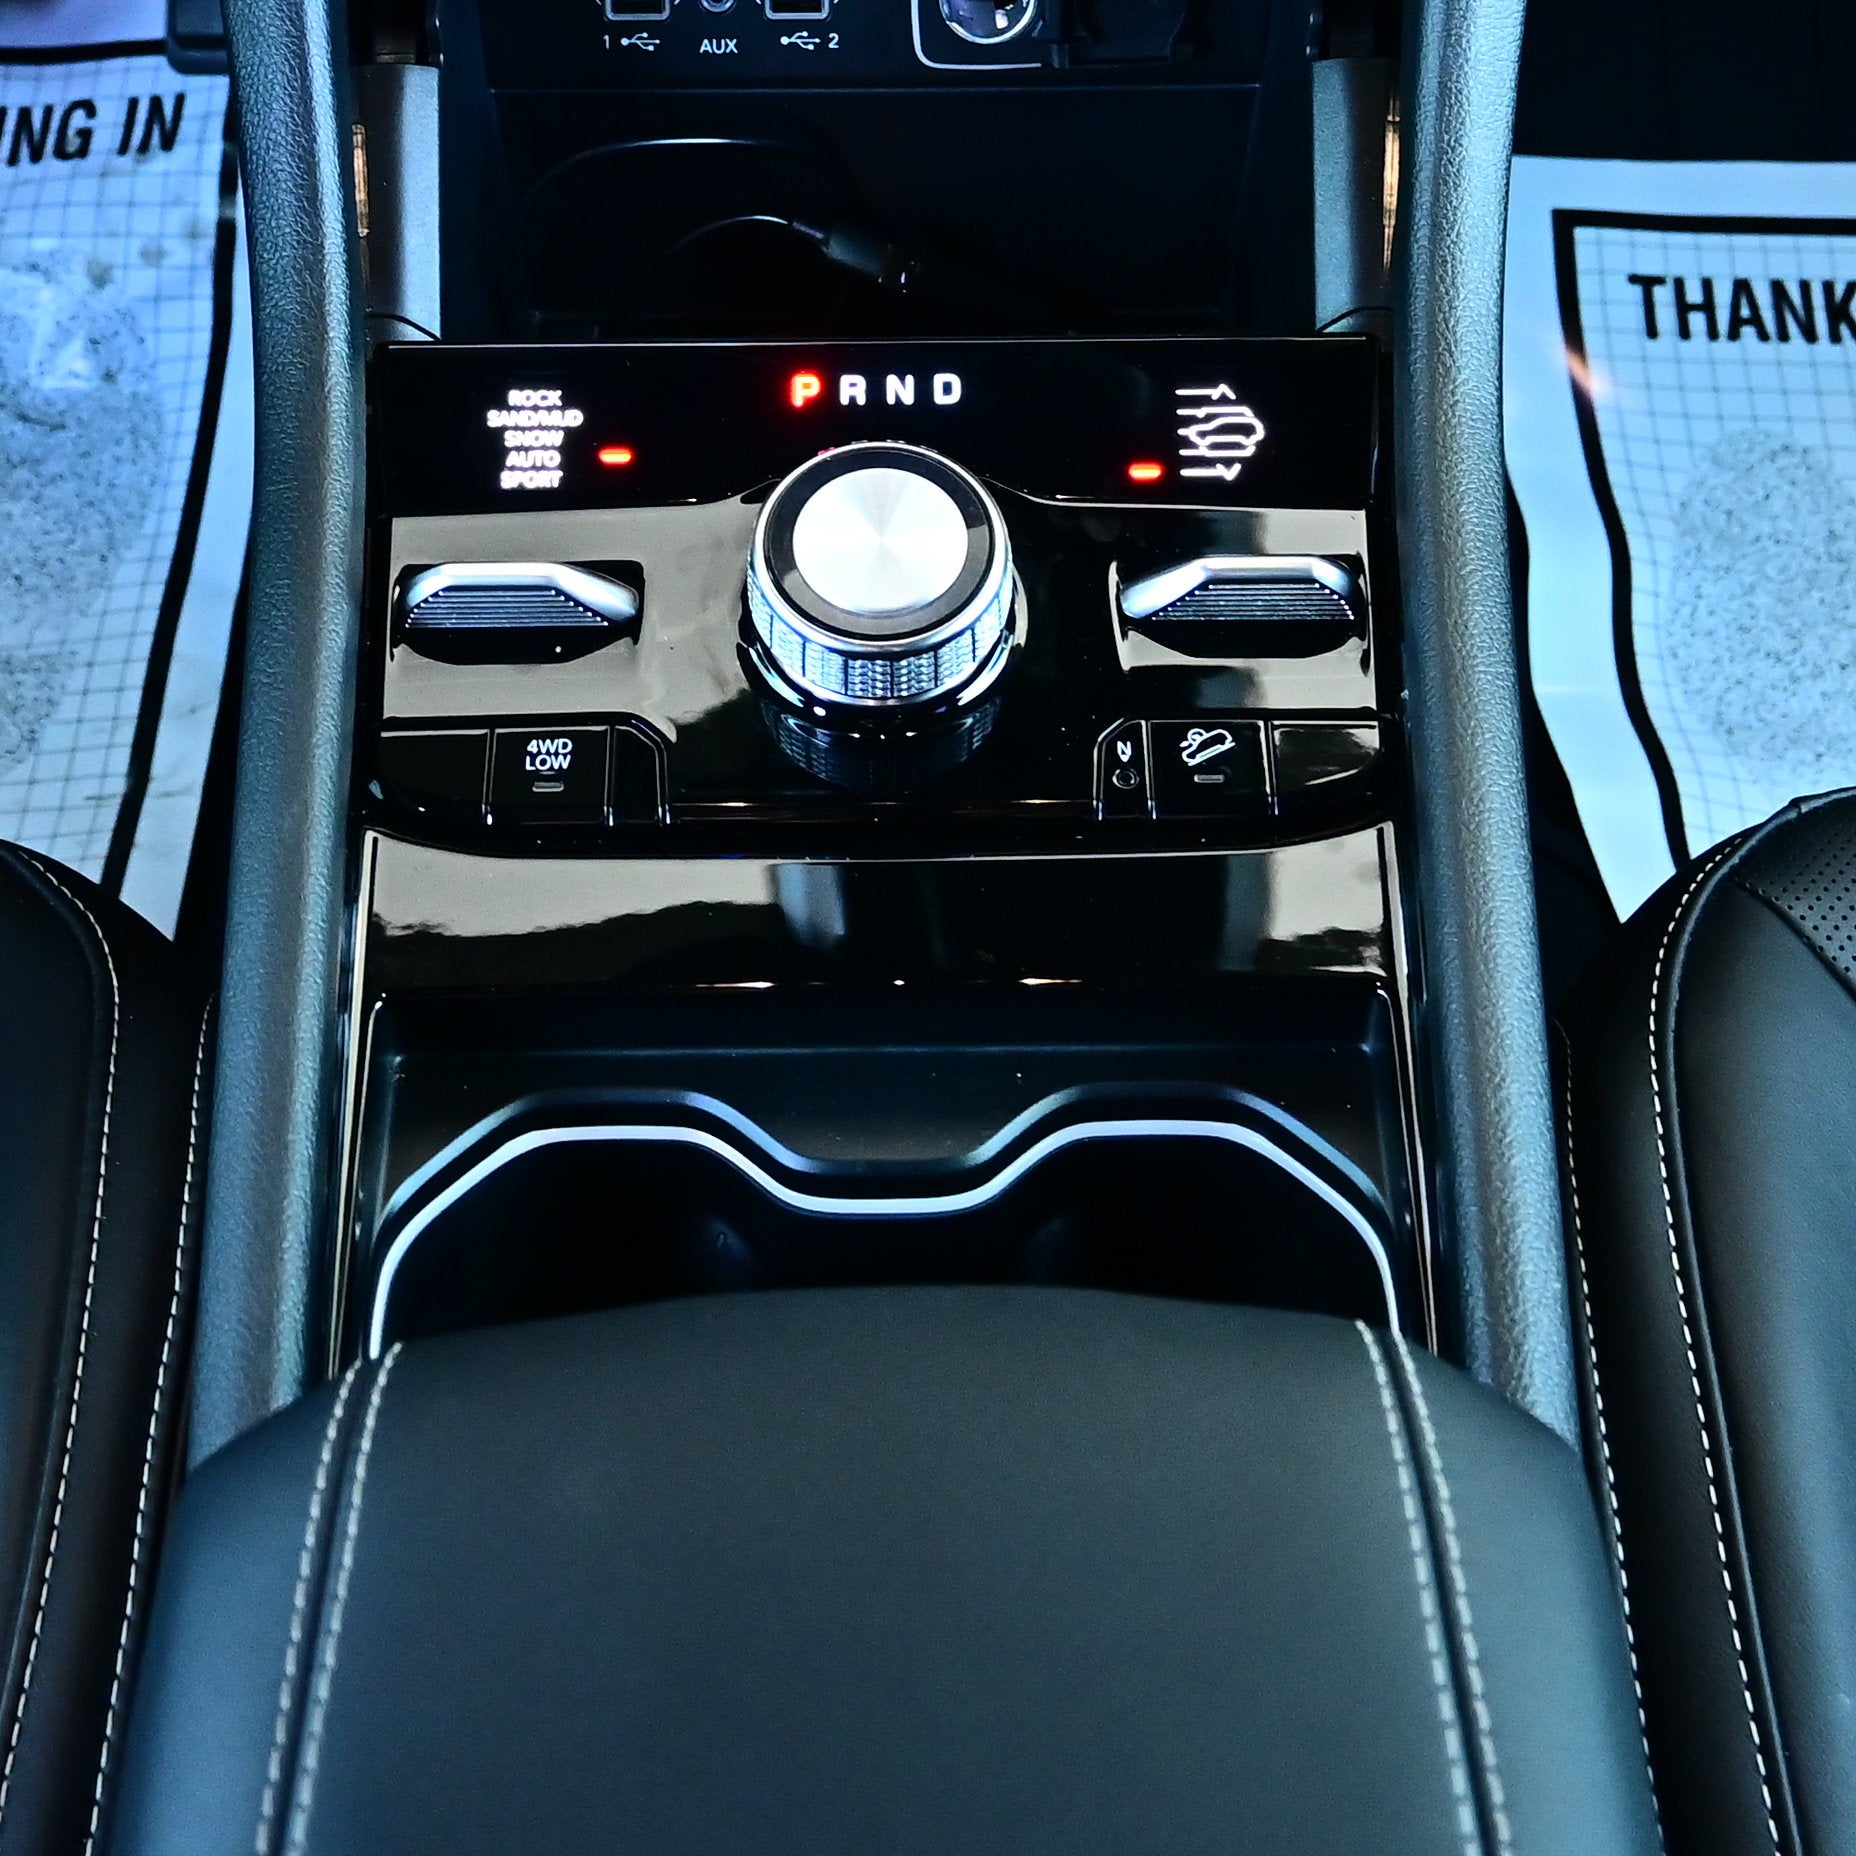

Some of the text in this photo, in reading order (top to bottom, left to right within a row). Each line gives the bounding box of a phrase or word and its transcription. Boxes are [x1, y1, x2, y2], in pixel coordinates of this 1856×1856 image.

[603, 34, 610, 49] 1
[700, 38, 738, 55] AUX
[828, 33, 840, 49] 2
[117, 92, 186, 156] IN
[508, 389, 563, 407] ROCK
[790, 372, 962, 407] P R N D
[504, 429, 564, 447] SNOW
[505, 449, 561, 468] AUTO
[500, 469, 564, 489] SPORT
[526, 738, 573, 754] 4WD
[525, 754, 572, 771] LOW
